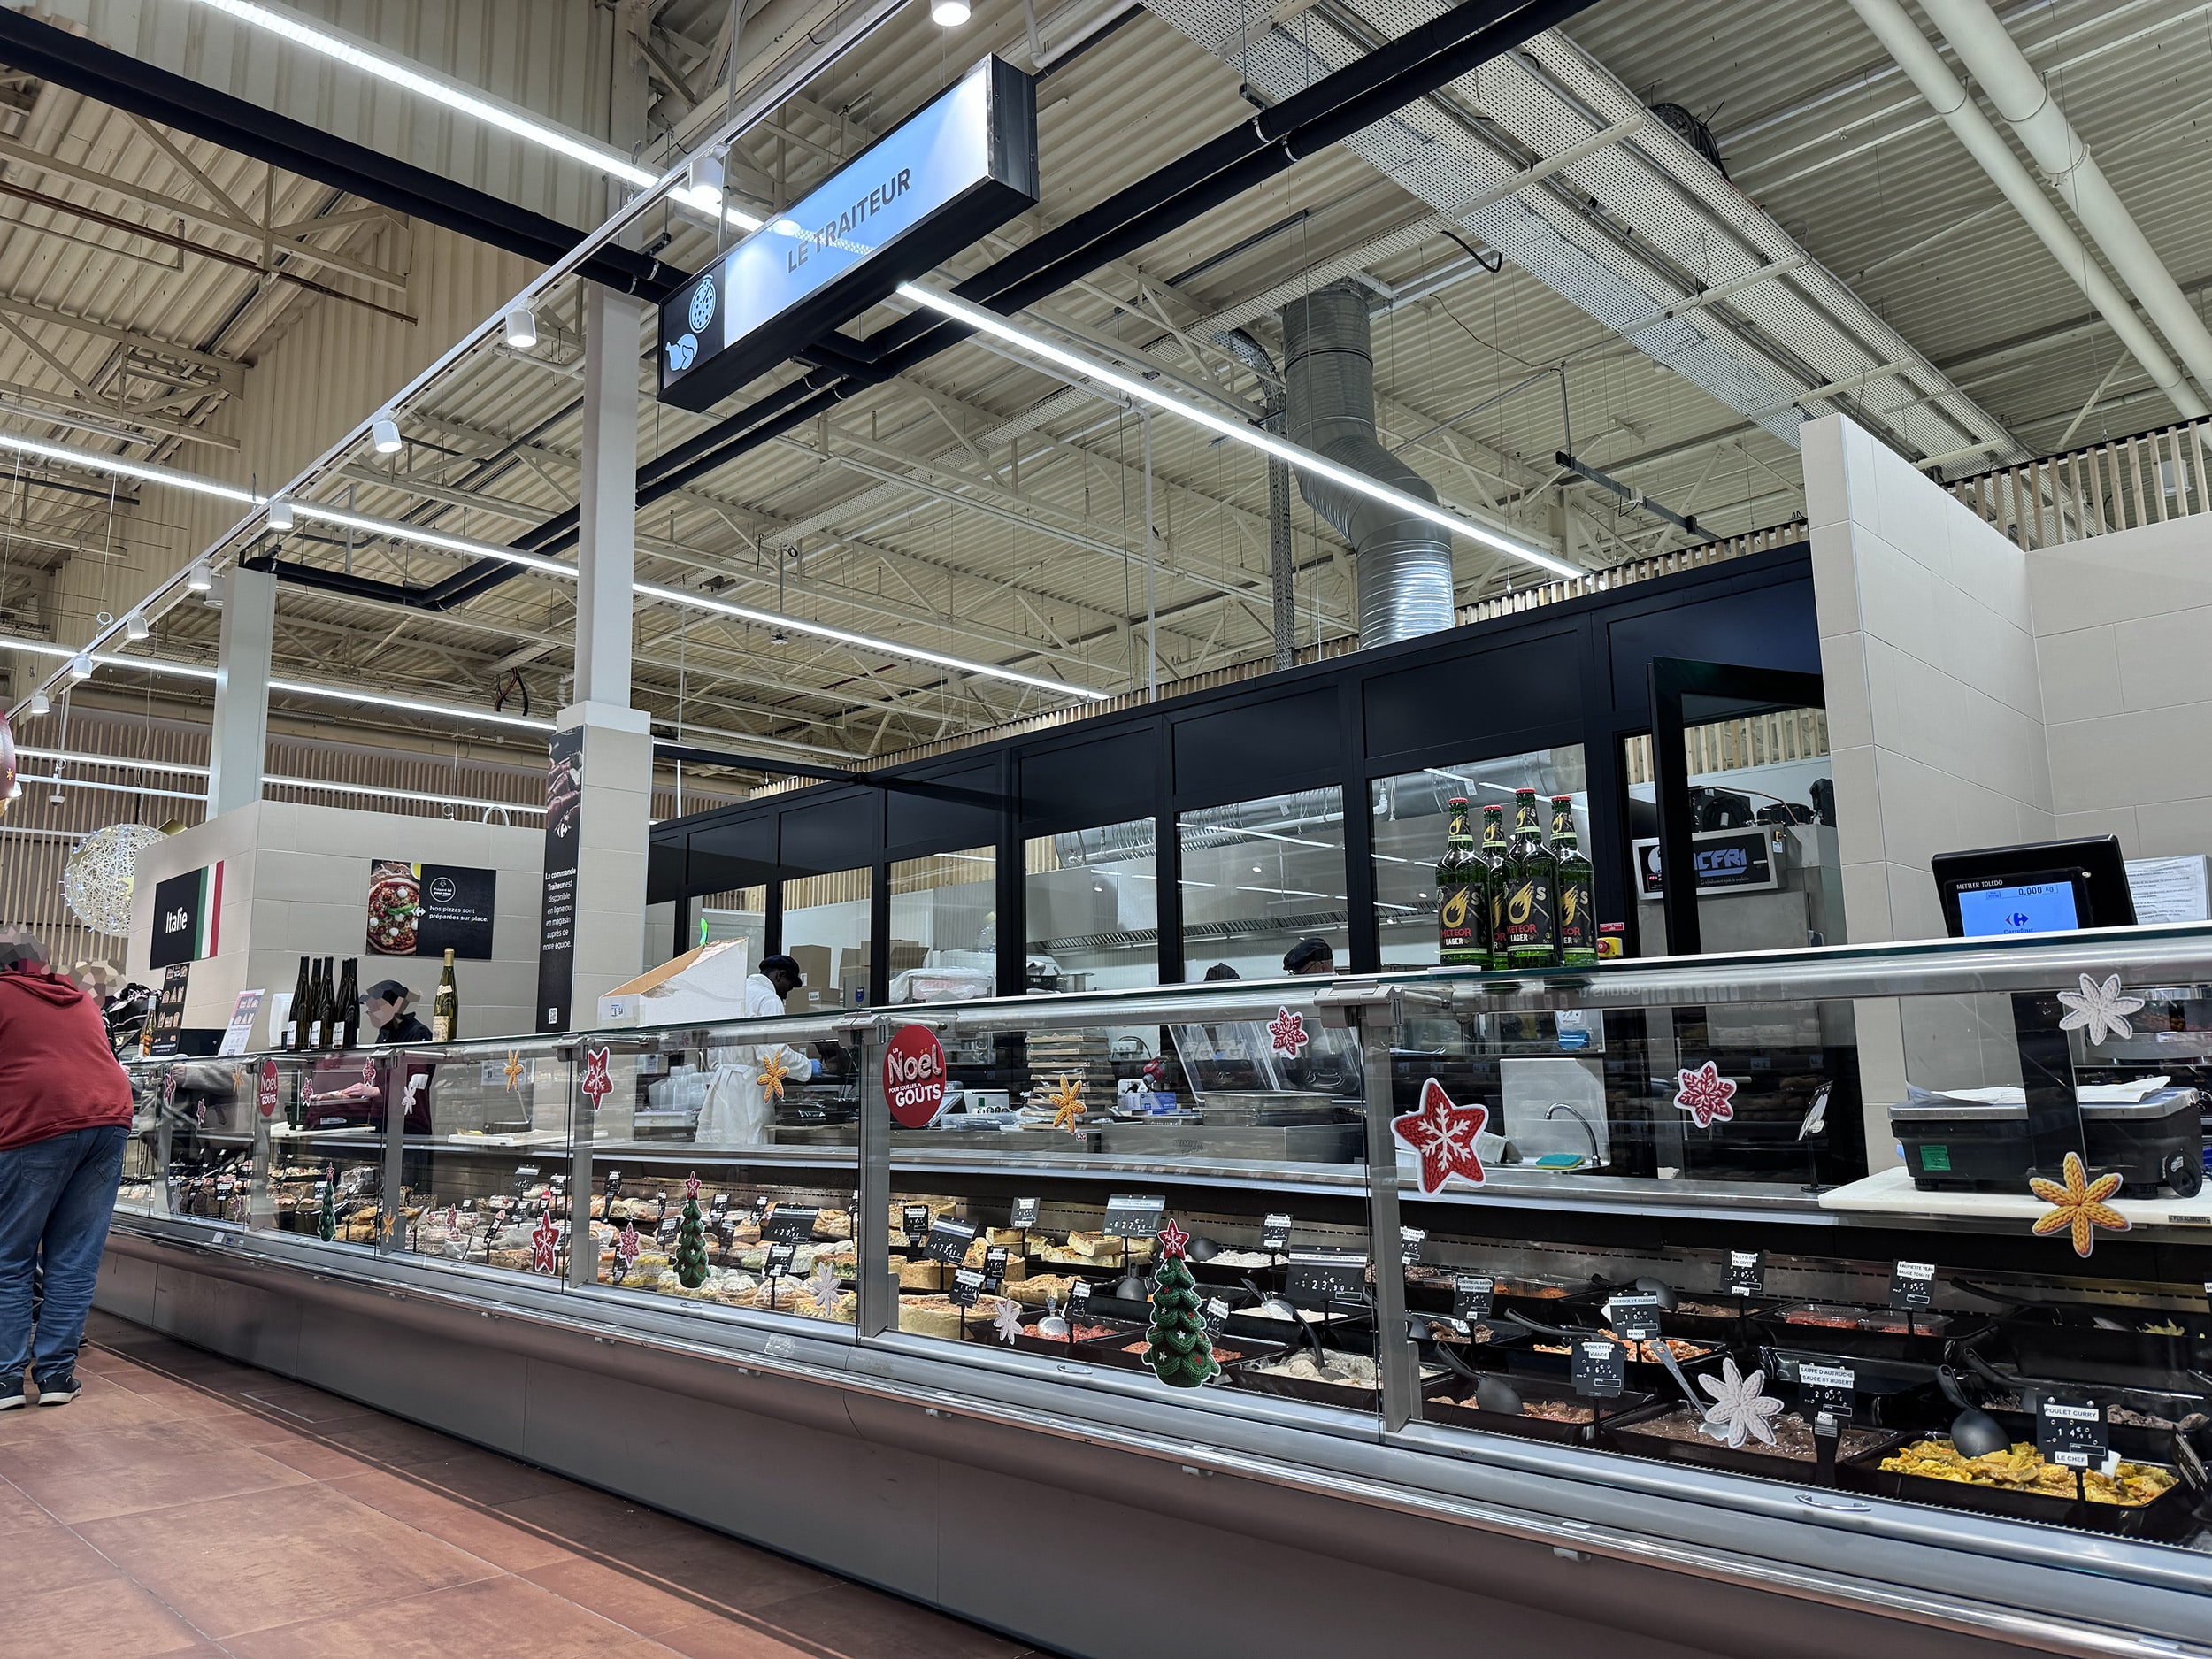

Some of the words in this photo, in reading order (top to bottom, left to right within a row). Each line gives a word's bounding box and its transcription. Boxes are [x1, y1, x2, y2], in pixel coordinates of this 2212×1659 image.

[787, 240, 809, 273] LE
[813, 167, 910, 254] TRAITEUR
[551, 867, 577, 879] commande
[548, 881, 565, 891] Traiteur
[2018, 886, 2042, 896] 0.000
[548, 892, 571, 903] disponible
[554, 906, 565, 916] ligne
[165, 906, 188, 934] Italie
[552, 916, 572, 926] magasin
[546, 929, 562, 939] auprès
[563, 927, 569, 936] de
[1507, 923, 1538, 934] METEOR
[1510, 933, 1528, 942] LAGER
[887, 1043, 942, 1085] Noël
